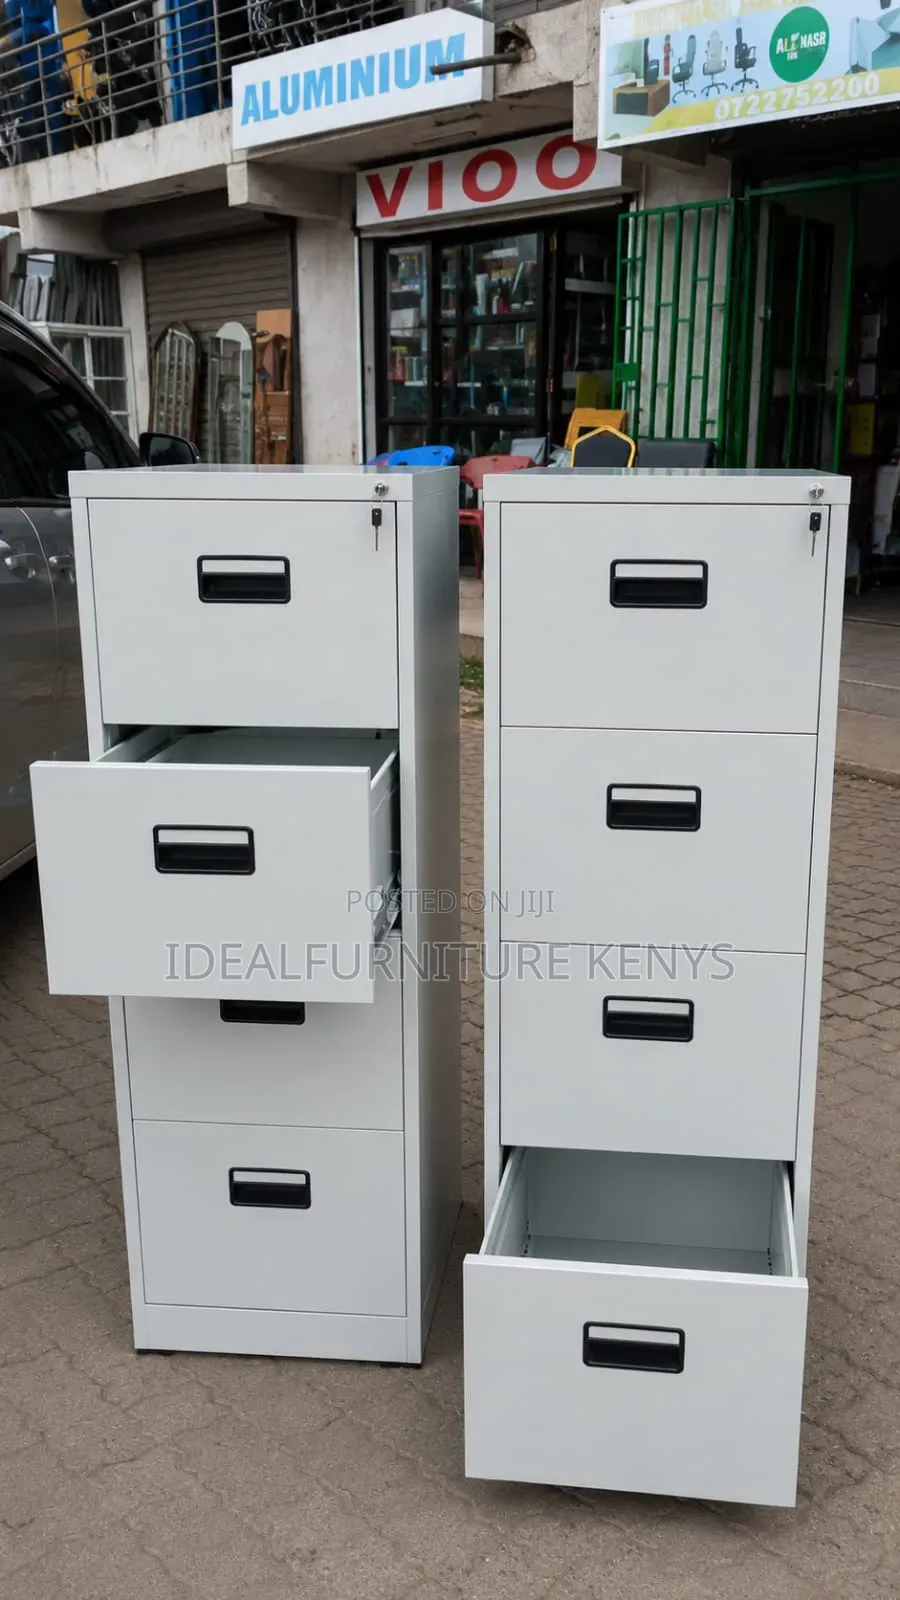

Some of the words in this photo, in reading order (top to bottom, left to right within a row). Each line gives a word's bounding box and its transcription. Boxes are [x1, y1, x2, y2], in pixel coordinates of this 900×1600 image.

[800, 30, 826, 49] NASR
[240, 32, 466, 126] ALUMINIUM
[714, 71, 880, 121] 0722752200
[365, 134, 597, 218] VIOO
